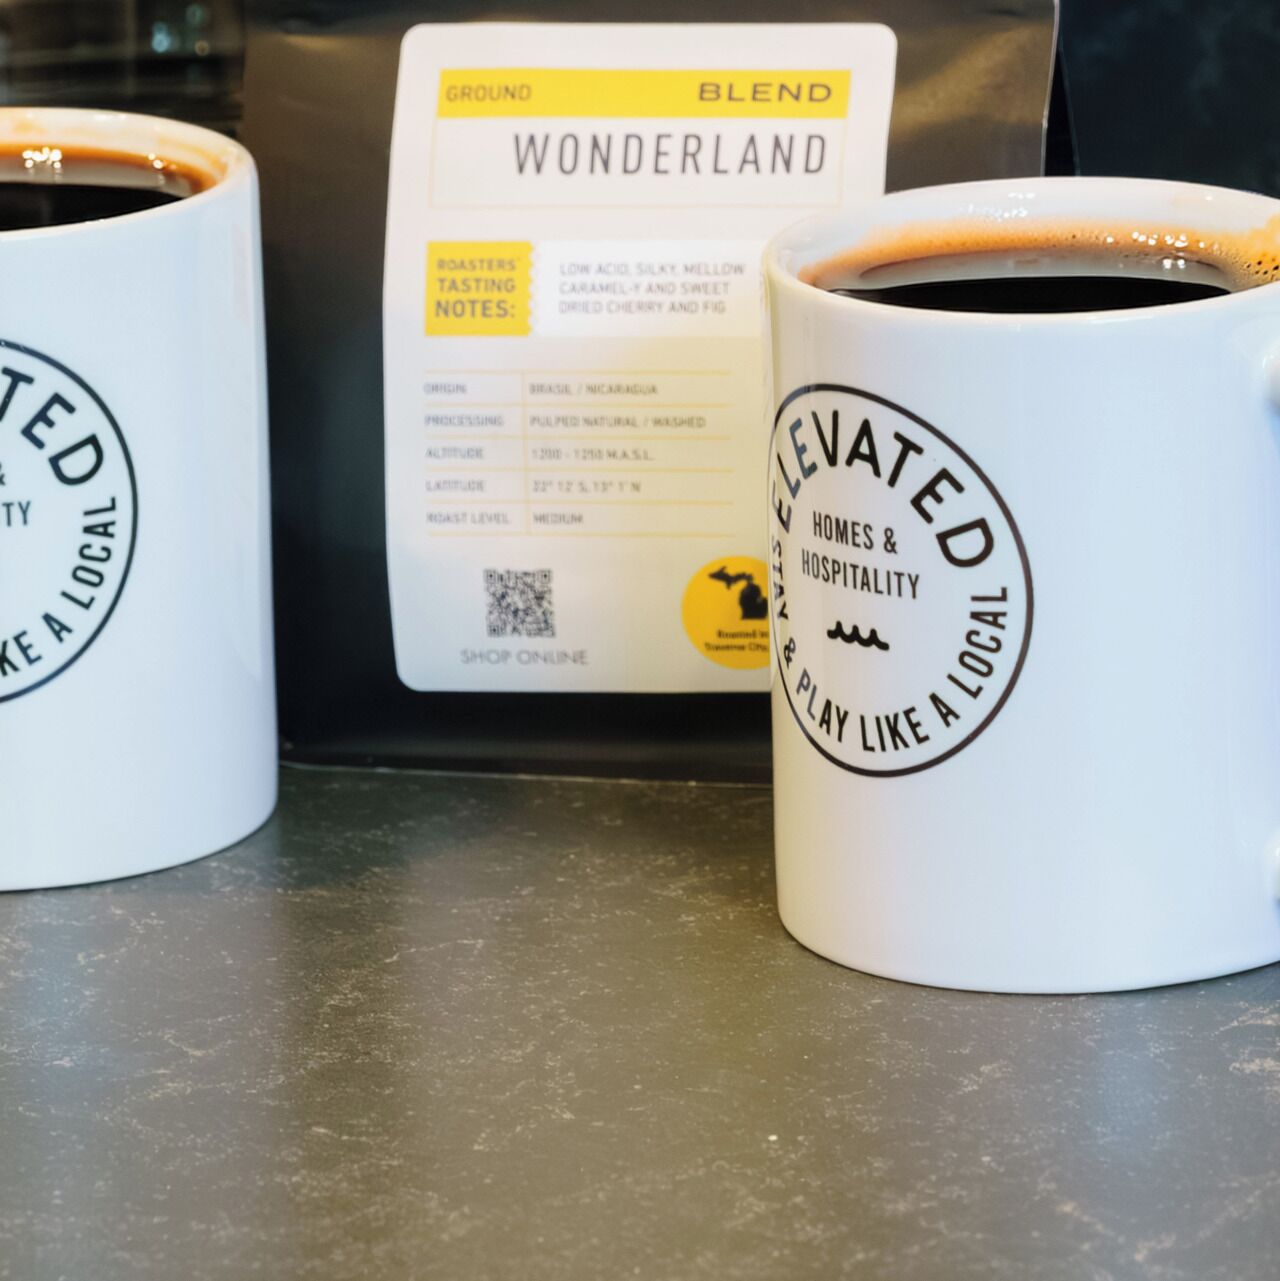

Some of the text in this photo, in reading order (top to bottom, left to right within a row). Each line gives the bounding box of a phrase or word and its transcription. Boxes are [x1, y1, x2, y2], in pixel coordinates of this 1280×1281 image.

[446, 84, 532, 103] GROUND
[698, 82, 832, 102] BLEND
[514, 133, 826, 175] WONDERLAND
[559, 263, 590, 276] LOW
[683, 263, 746, 276] MELLOW
[437, 278, 516, 293] TASTING
[645, 282, 676, 295] AND
[680, 282, 730, 295] SWEET
[434, 300, 516, 318] NOTES:
[558, 301, 727, 314] DRIED CHERRY AND FIG
[771, 409, 995, 568] ELEVATED
[813, 511, 898, 555] HOMES &
[41, 612, 74, 643] A
[60, 496, 117, 610] LOCAL
[801, 548, 920, 600] HOSPITALITY
[771, 533, 1008, 753] STAY & PLAY LIKE A LOCAL
[460, 650, 589, 665] SHOP ONLINE
